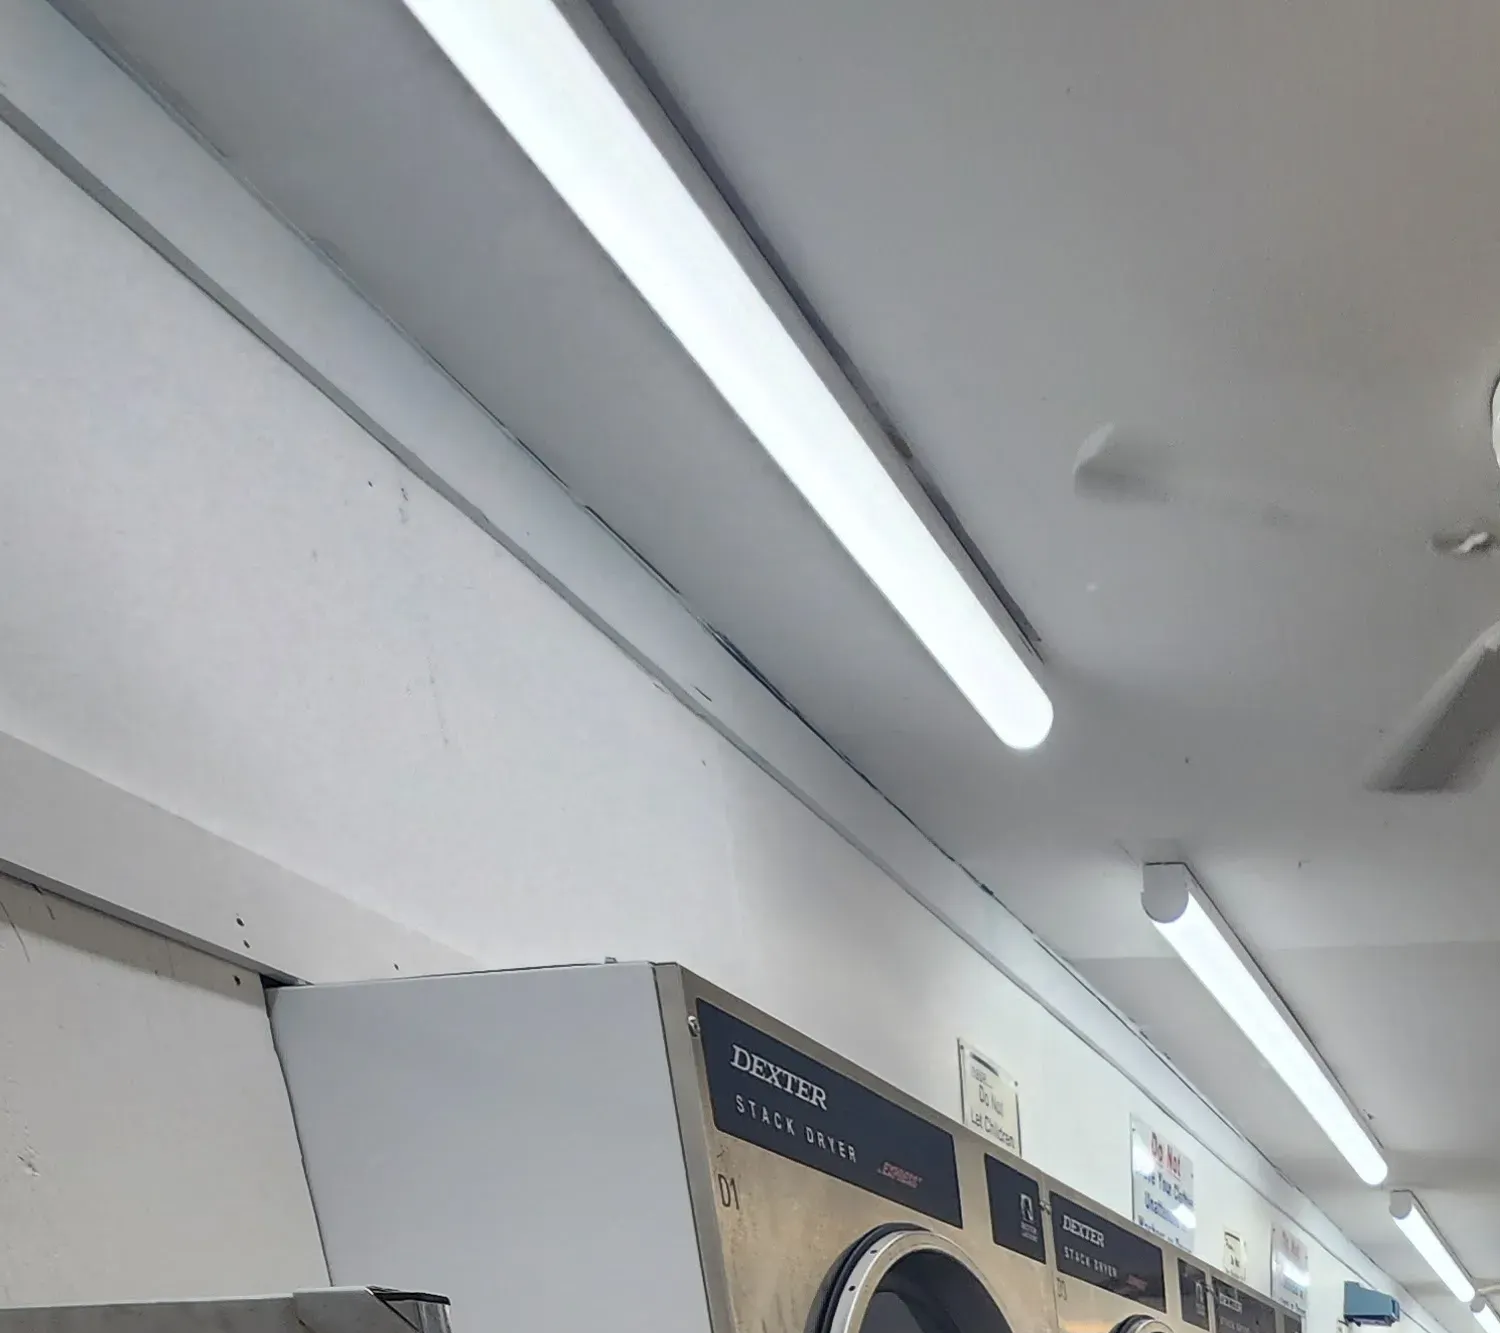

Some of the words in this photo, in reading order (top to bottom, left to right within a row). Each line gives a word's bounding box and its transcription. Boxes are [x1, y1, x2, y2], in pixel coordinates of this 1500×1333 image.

[731, 1044, 828, 1111] DEXTER
[735, 1094, 796, 1136] STACK
[805, 1126, 858, 1164] DRYER
[717, 1173, 740, 1210] D1
[1062, 1214, 1105, 1248] DEXTER
[1064, 1246, 1090, 1268] STACK
